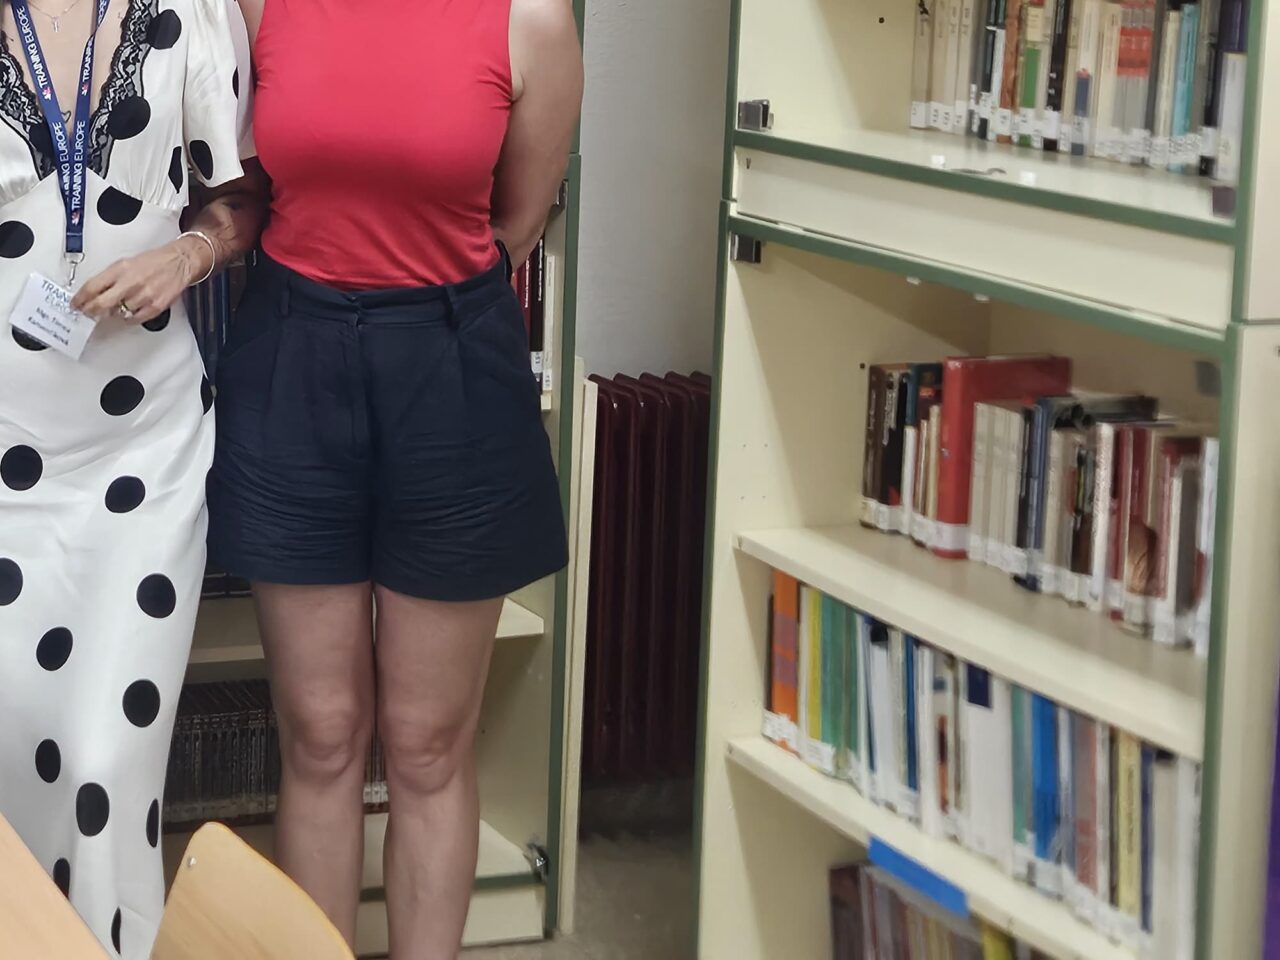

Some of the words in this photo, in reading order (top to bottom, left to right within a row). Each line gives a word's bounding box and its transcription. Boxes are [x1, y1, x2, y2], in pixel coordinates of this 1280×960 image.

[17, 5, 37, 42] EUROPE
[29, 42, 51, 88] TRAINING
[52, 121, 71, 162] EUROPE
[72, 120, 85, 161] EUROPE
[71, 162, 82, 210] TRAINING
